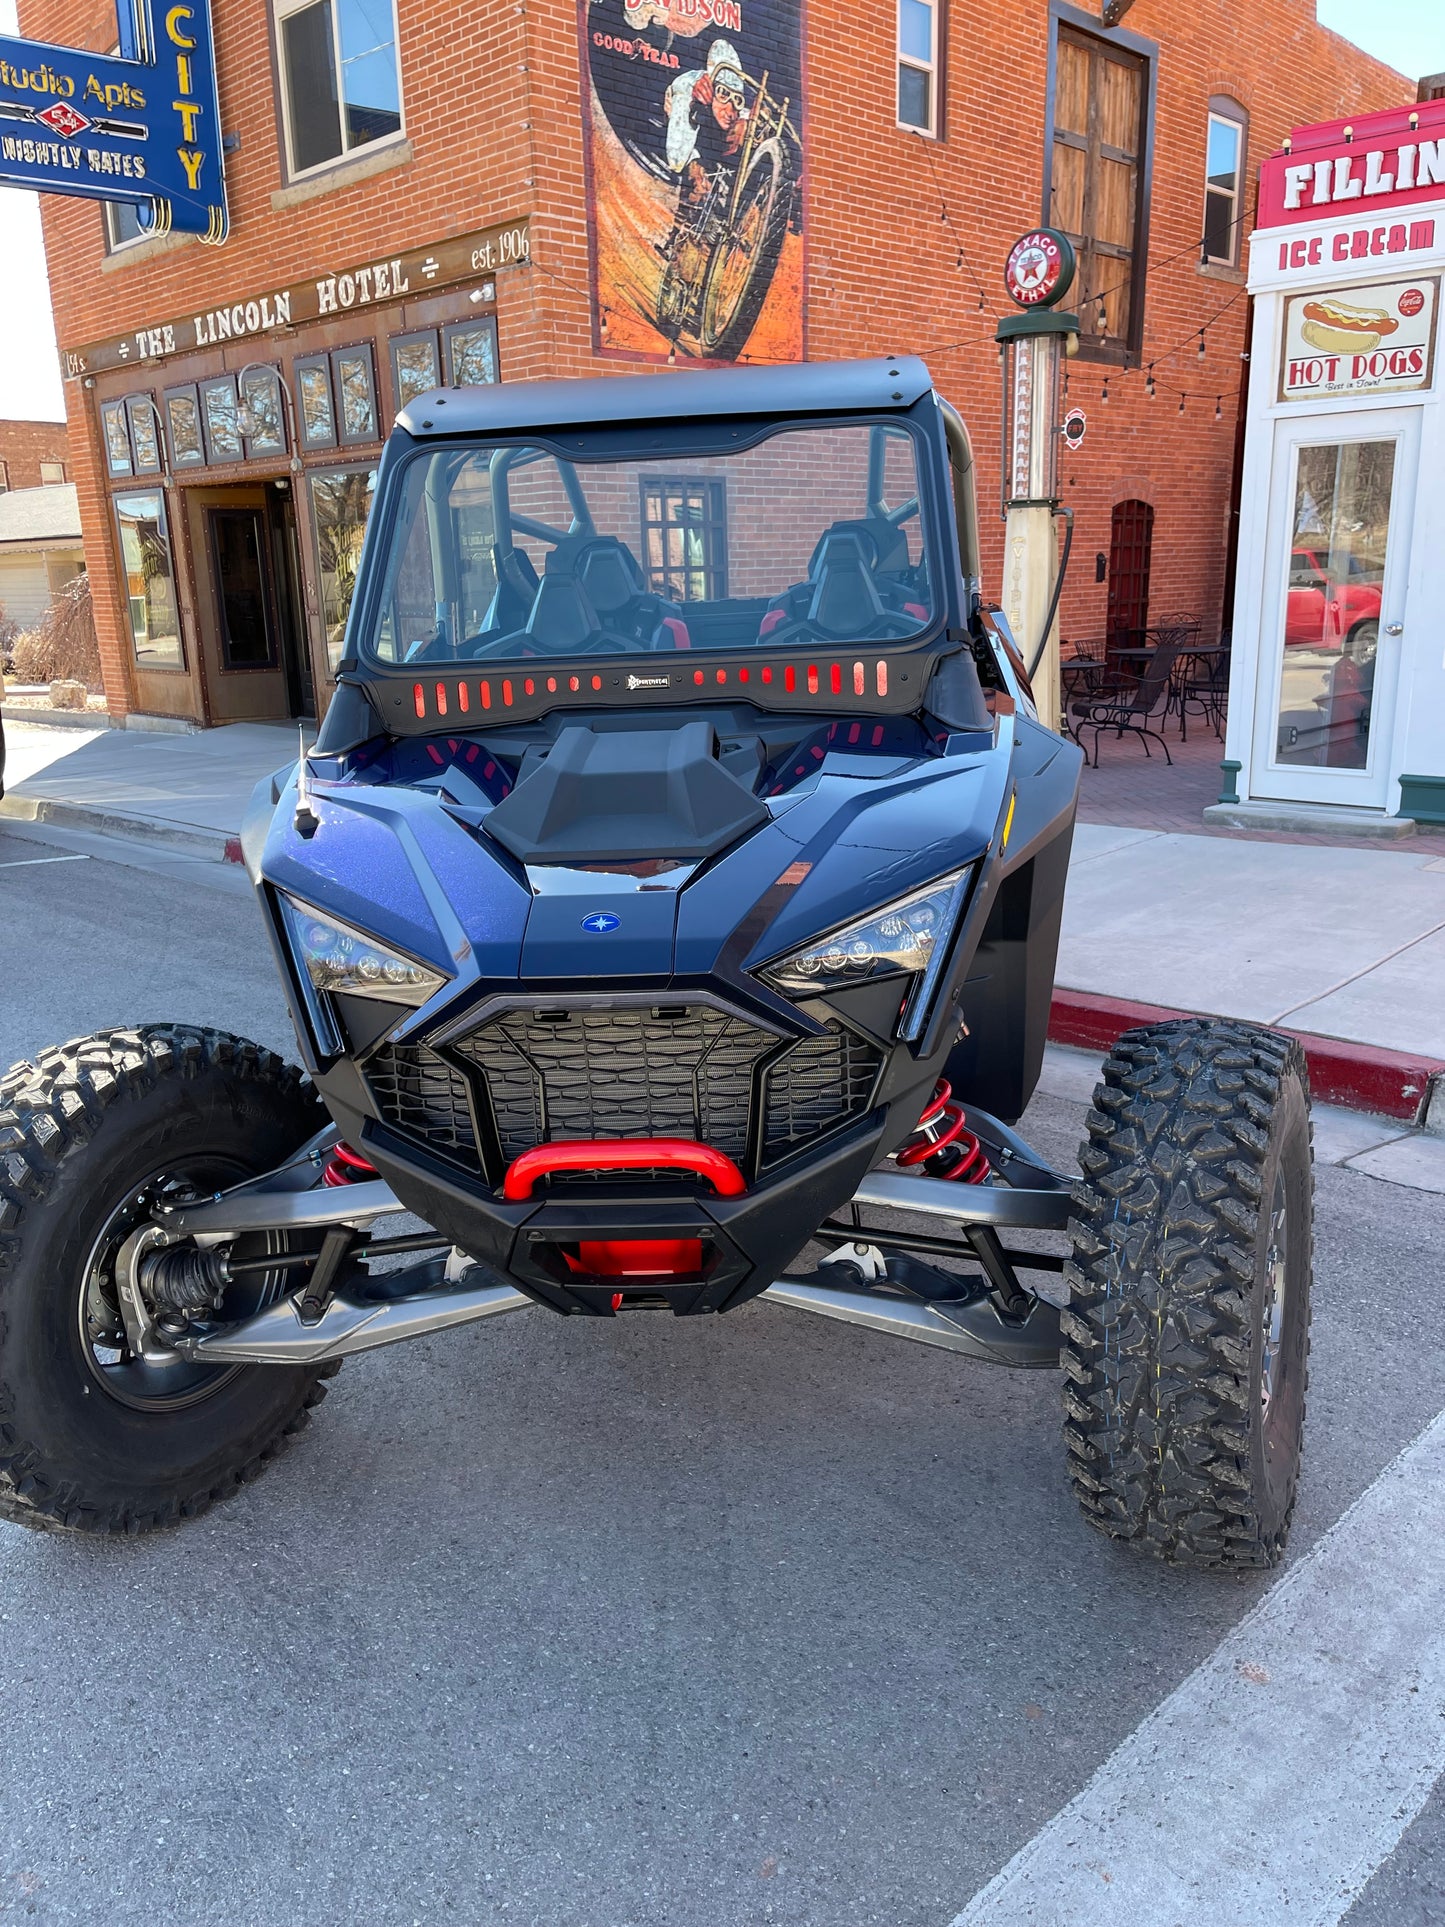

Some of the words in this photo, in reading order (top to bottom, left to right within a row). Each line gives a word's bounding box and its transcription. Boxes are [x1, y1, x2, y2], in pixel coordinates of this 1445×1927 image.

[625, 0, 741, 31] DSON
[593, 32, 634, 56] GOOD
[0, 60, 75, 97] tudio
[83, 74, 147, 112] Apts
[166, 6, 205, 190] CITY
[1, 136, 81, 170] NIGHTLY
[88, 149, 146, 179] RATES
[472, 240, 496, 270] est.
[499, 226, 530, 263] 1906
[1279, 237, 1323, 270] ICE
[1332, 219, 1435, 261] CREAM
[135, 325, 176, 359] THE
[194, 292, 291, 346] LINCOLN
[316, 260, 409, 314] HOTEL
[1012, 279, 1056, 301] ETHYL
[1289, 357, 1341, 386] HOT
[1352, 348, 1424, 379] DOGS
[1325, 381, 1344, 391] Best
[1346, 379, 1354, 389] in
[1356, 378, 1381, 388] Town!
